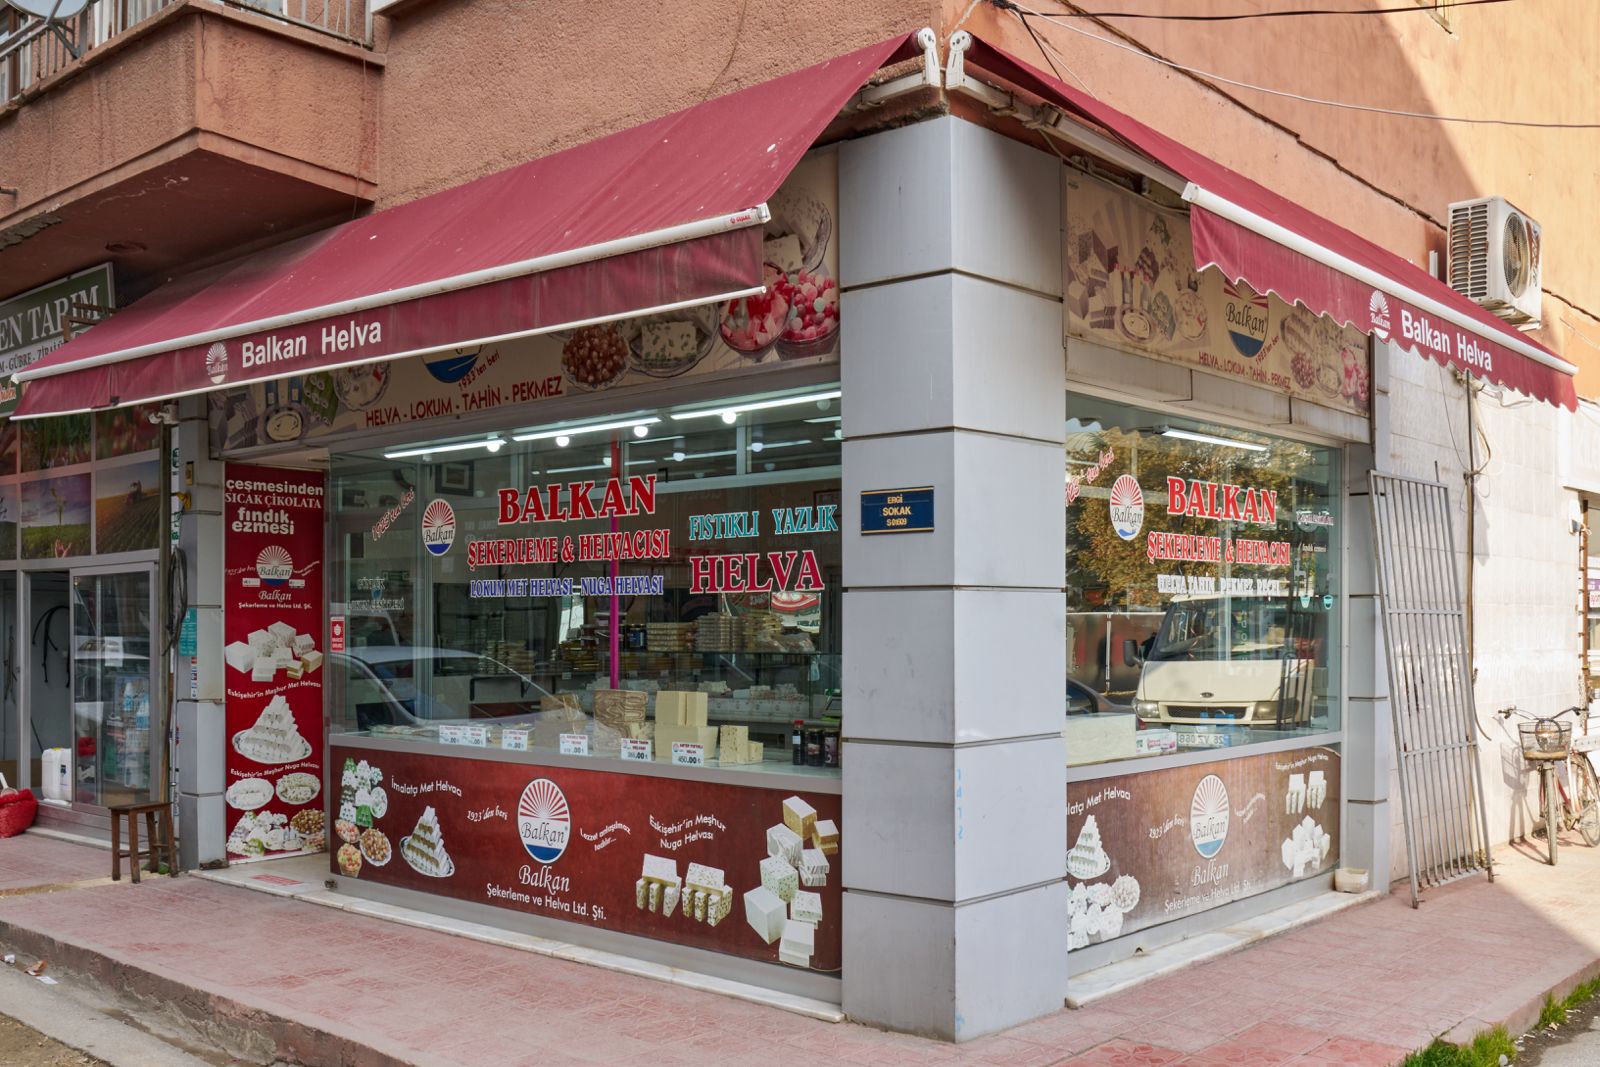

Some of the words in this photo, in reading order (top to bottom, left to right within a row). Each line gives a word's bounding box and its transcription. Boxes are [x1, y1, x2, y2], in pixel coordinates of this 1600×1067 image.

[1226, 302, 1266, 337] Balkan
[242, 335, 308, 368] Balkan
[321, 320, 382, 355] Helva
[1401, 309, 1451, 355] Balkan
[1457, 333, 1492, 372] Helva
[1199, 351, 1219, 369] HELVA
[1224, 358, 1246, 376] LOKUM
[1249, 366, 1267, 383] TAHİN
[1271, 372, 1292, 390] PEKMEZ
[366, 407, 401, 427] HELVA
[410, 399, 453, 420] LOKUM
[462, 384, 502, 411] TAHİN
[512, 375, 563, 402] PEKMEZ
[226, 479, 324, 496] çeşmesinden
[498, 473, 657, 525] BALKAN
[225, 492, 262, 506] SICAK
[264, 493, 322, 509] ÇİKOLATA
[882, 506, 912, 517] SOKAK
[1167, 476, 1277, 525] BALKAN
[237, 507, 289, 523] fındık
[689, 511, 759, 541] FISTIKLI
[771, 504, 839, 535] YAZLIK
[1111, 504, 1142, 528] Balkan
[232, 521, 294, 535] ezmesi
[424, 524, 454, 545] Balkan
[467, 536, 558, 572] ŞEKERLEME
[561, 536, 575, 563] &
[579, 529, 670, 562] HELVACISI
[1147, 531, 1221, 564] ŞEKERLEME
[1225, 539, 1233, 563] &
[1236, 539, 1291, 566] HELVACISI
[259, 565, 291, 578] Balkan
[690, 550, 825, 594] HELVA
[259, 589, 292, 603] Balkan
[470, 578, 506, 598] LOKUM
[507, 578, 528, 598] MET
[530, 577, 574, 598] HELVASI
[580, 576, 613, 597] NUGA
[614, 575, 664, 597] HELVASI
[288, 681, 299, 690] Met
[419, 778, 434, 794] Met
[1086, 794, 1102, 809] Met
[521, 822, 565, 846] Balkan
[649, 814, 694, 838] Eskişehir'in
[696, 813, 727, 833] Meşhur
[1194, 816, 1227, 840] Balkan
[660, 837, 682, 851] Nuga
[684, 831, 714, 845] Helvası
[519, 864, 570, 895] Balkan
[1191, 859, 1229, 888] Balkan
[486, 883, 530, 903] Şekerleme
[532, 896, 542, 905] ve
[545, 895, 570, 912] Helva
[573, 901, 589, 917] Ltd.
[592, 905, 607, 921] Şti.
[1211, 886, 1230, 899] Helva
